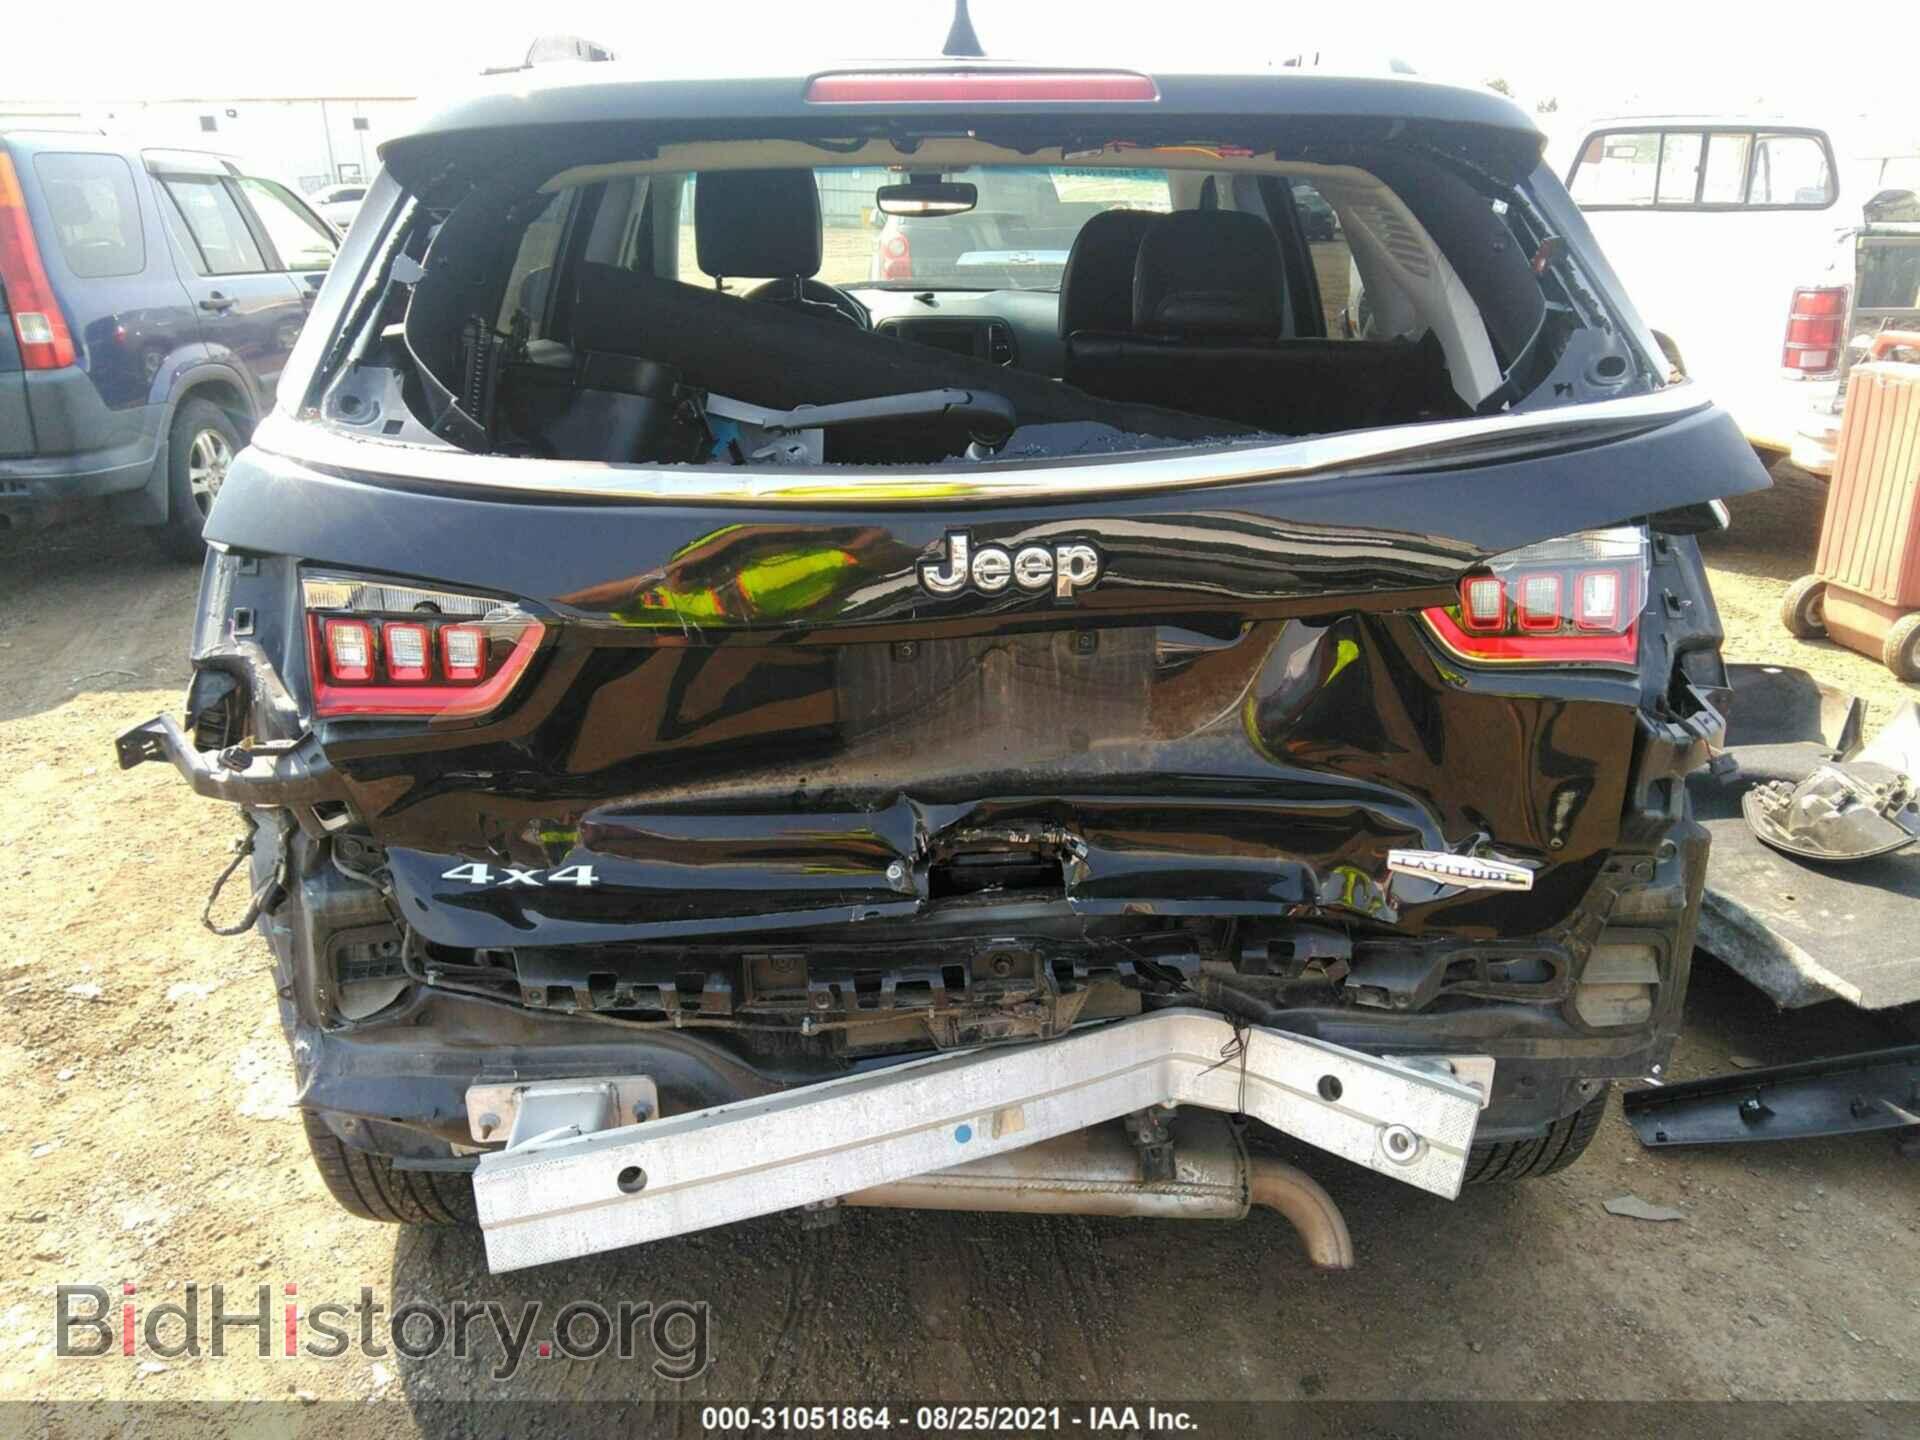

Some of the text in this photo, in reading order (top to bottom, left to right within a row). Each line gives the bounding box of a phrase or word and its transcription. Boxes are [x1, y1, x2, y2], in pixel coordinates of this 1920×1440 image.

[923, 534, 1099, 598] Jeep
[441, 863, 599, 887] 4x4
[1400, 858, 1518, 883] LATITUDE
